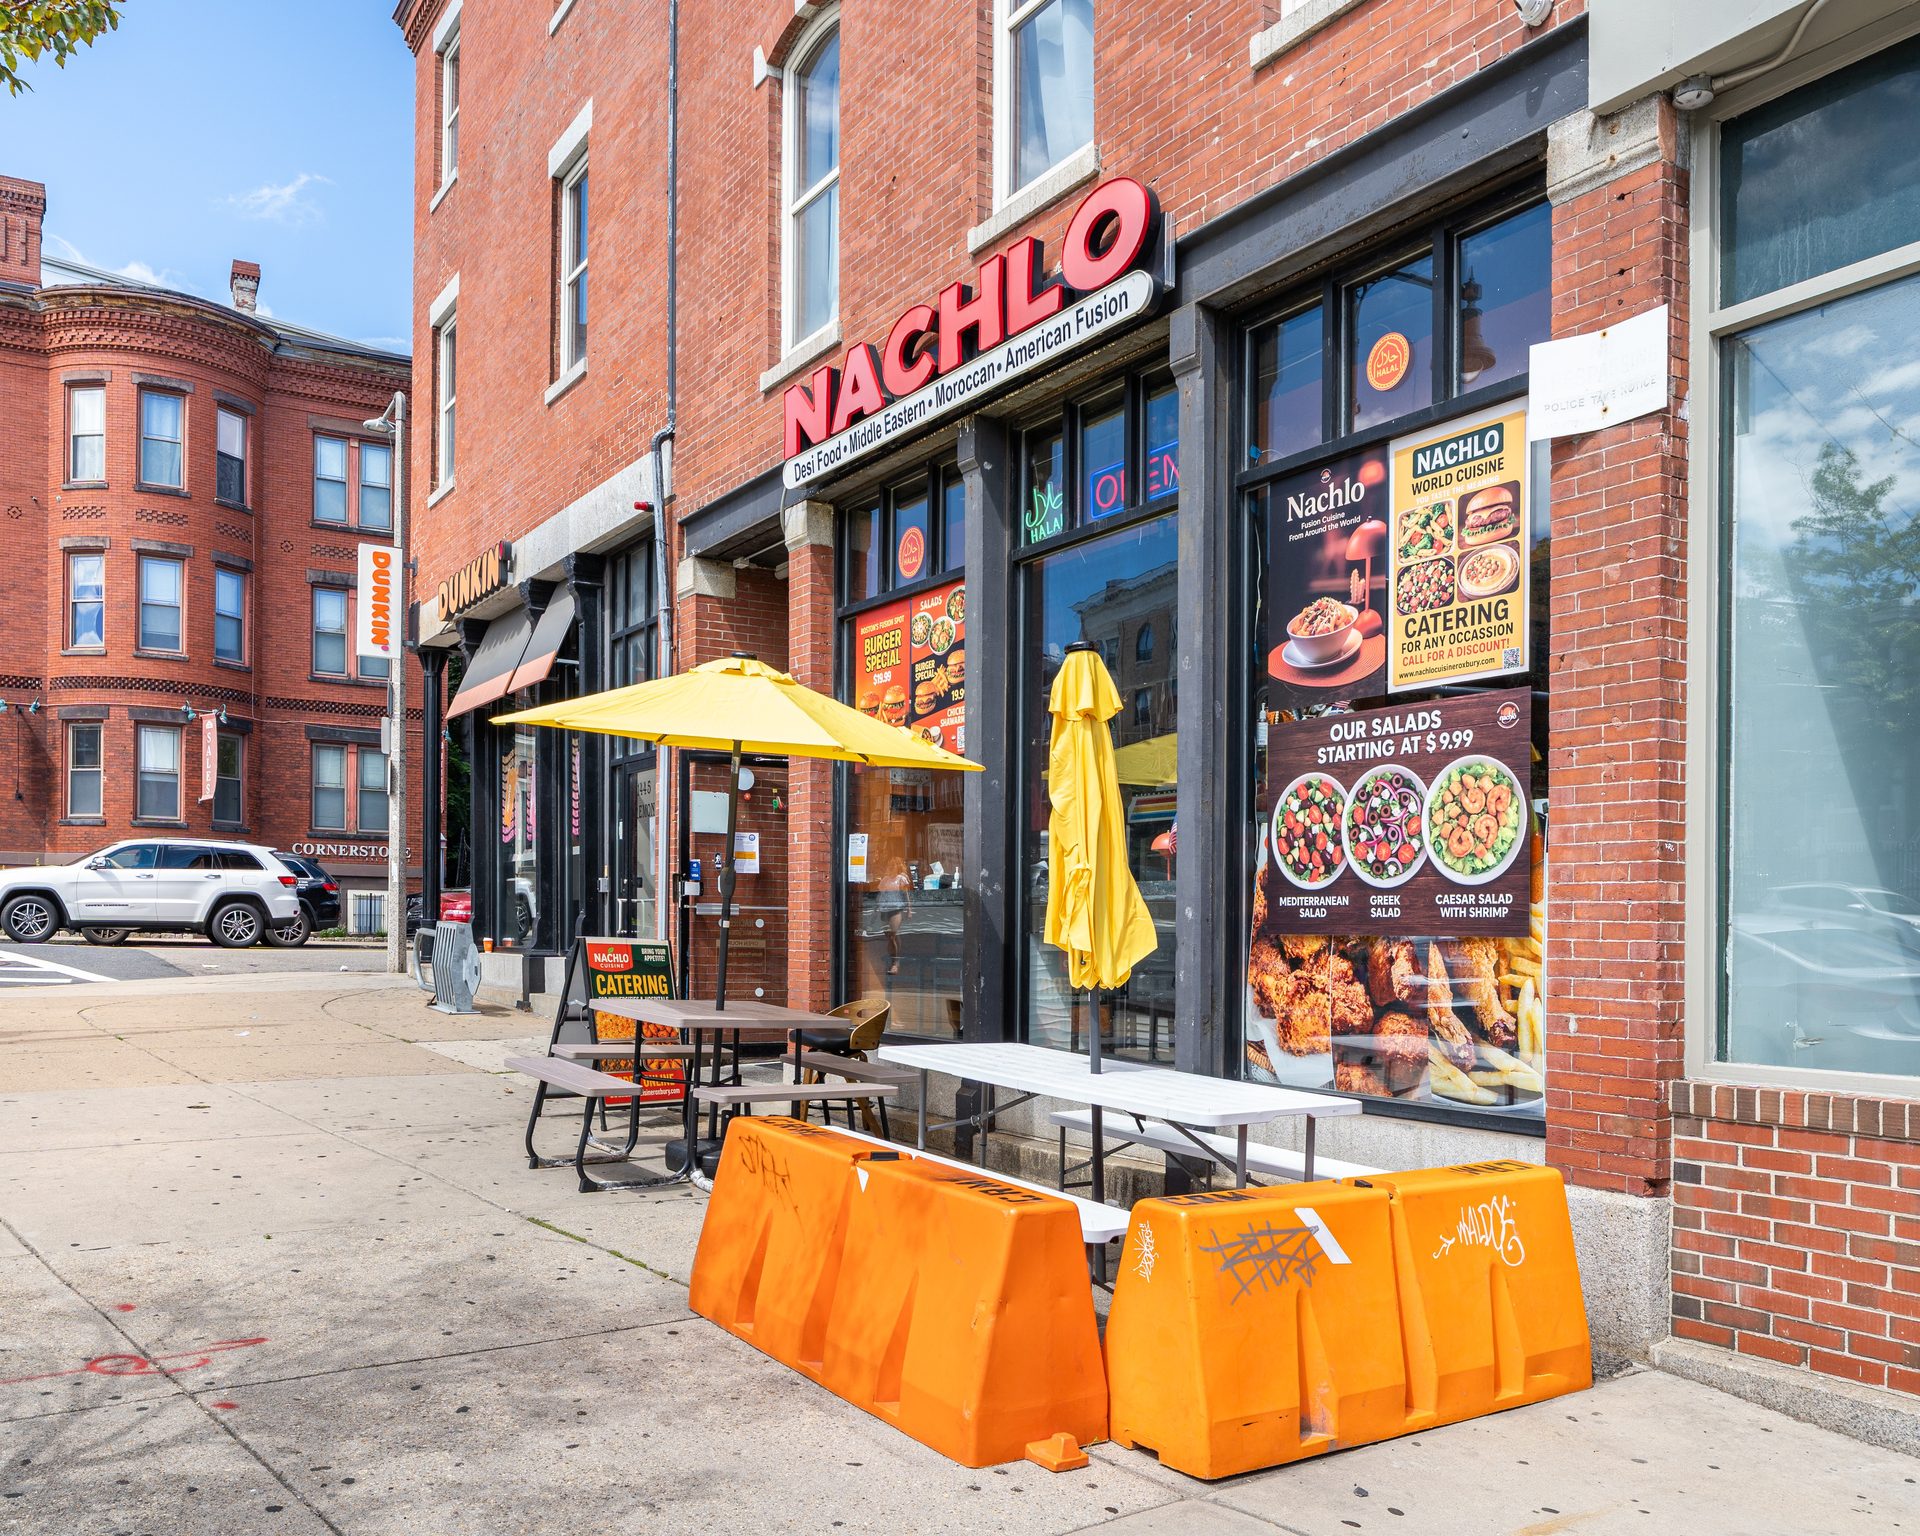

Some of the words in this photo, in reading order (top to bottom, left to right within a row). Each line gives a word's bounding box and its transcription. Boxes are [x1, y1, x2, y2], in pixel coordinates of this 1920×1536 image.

[783, 176, 1152, 461] NACHLO
[1376, 363, 1399, 378] HALAL
[793, 456, 815, 483] Desi
[816, 440, 842, 473] Food
[849, 422, 882, 454] Middle
[884, 398, 927, 441] Eastern
[935, 365, 996, 409] Moroccan
[1005, 320, 1071, 372] American
[1075, 288, 1129, 339] Fusion
[1544, 397, 1585, 413] POLICE
[1417, 429, 1500, 475] NACHLO
[1412, 472, 1453, 495] WORLD
[1456, 456, 1505, 483] CUISINE
[1286, 477, 1365, 522] Nachlo
[1416, 496, 1429, 505] YOU
[1432, 488, 1451, 500] TASTE
[1452, 485, 1465, 495] THE
[1466, 476, 1500, 491] MEANING
[1301, 518, 1321, 530] Fusion
[1321, 511, 1345, 524] Cuisine
[1289, 533, 1304, 542] From
[1305, 526, 1327, 537] Around
[1327, 523, 1339, 531] the
[438, 540, 504, 622] DUNKIN'
[371, 551, 391, 651] DUNKIN'
[920, 595, 943, 611] SALADS
[860, 624, 879, 636] BOSTON'S
[879, 619, 894, 629] FUSION
[894, 615, 905, 625] SPOT
[1404, 599, 1509, 639] CATERING
[864, 628, 902, 656] BURGER
[1401, 641, 1421, 655] FOR
[1424, 635, 1446, 650] ANY
[1448, 622, 1514, 644] OCCASSION
[865, 648, 901, 673] SPECIAL
[1402, 653, 1424, 667] CALL
[1427, 651, 1445, 662] FOR
[1447, 649, 1454, 659] A
[1456, 638, 1510, 657] DISCOUNT!
[915, 660, 936, 673] BURGER
[915, 668, 935, 682] SPECIAL
[1398, 657, 1495, 679] www.nachlocuisineroxbury.com
[873, 670, 892, 686] $19.99
[951, 687, 965, 702] 19.9
[947, 706, 965, 717] CHICKE
[1329, 719, 1366, 743] OUR
[1371, 710, 1442, 737] SALADS
[1317, 738, 1396, 764] STARTING
[1400, 735, 1422, 755] AT
[292, 842, 412, 859] CORNERSTOE
[1279, 895, 1349, 907] MEDITERRANEAN
[1370, 895, 1401, 906] GREEK
[1435, 894, 1475, 906] CAESAR
[1478, 893, 1513, 905] SALAD
[1299, 907, 1327, 918] SALAD
[1370, 907, 1401, 918] SALAD
[1440, 907, 1467, 918] WITH
[1469, 906, 1509, 918] SHRIMP
[593, 953, 629, 963] NACHLO
[596, 974, 669, 995] CATERING
